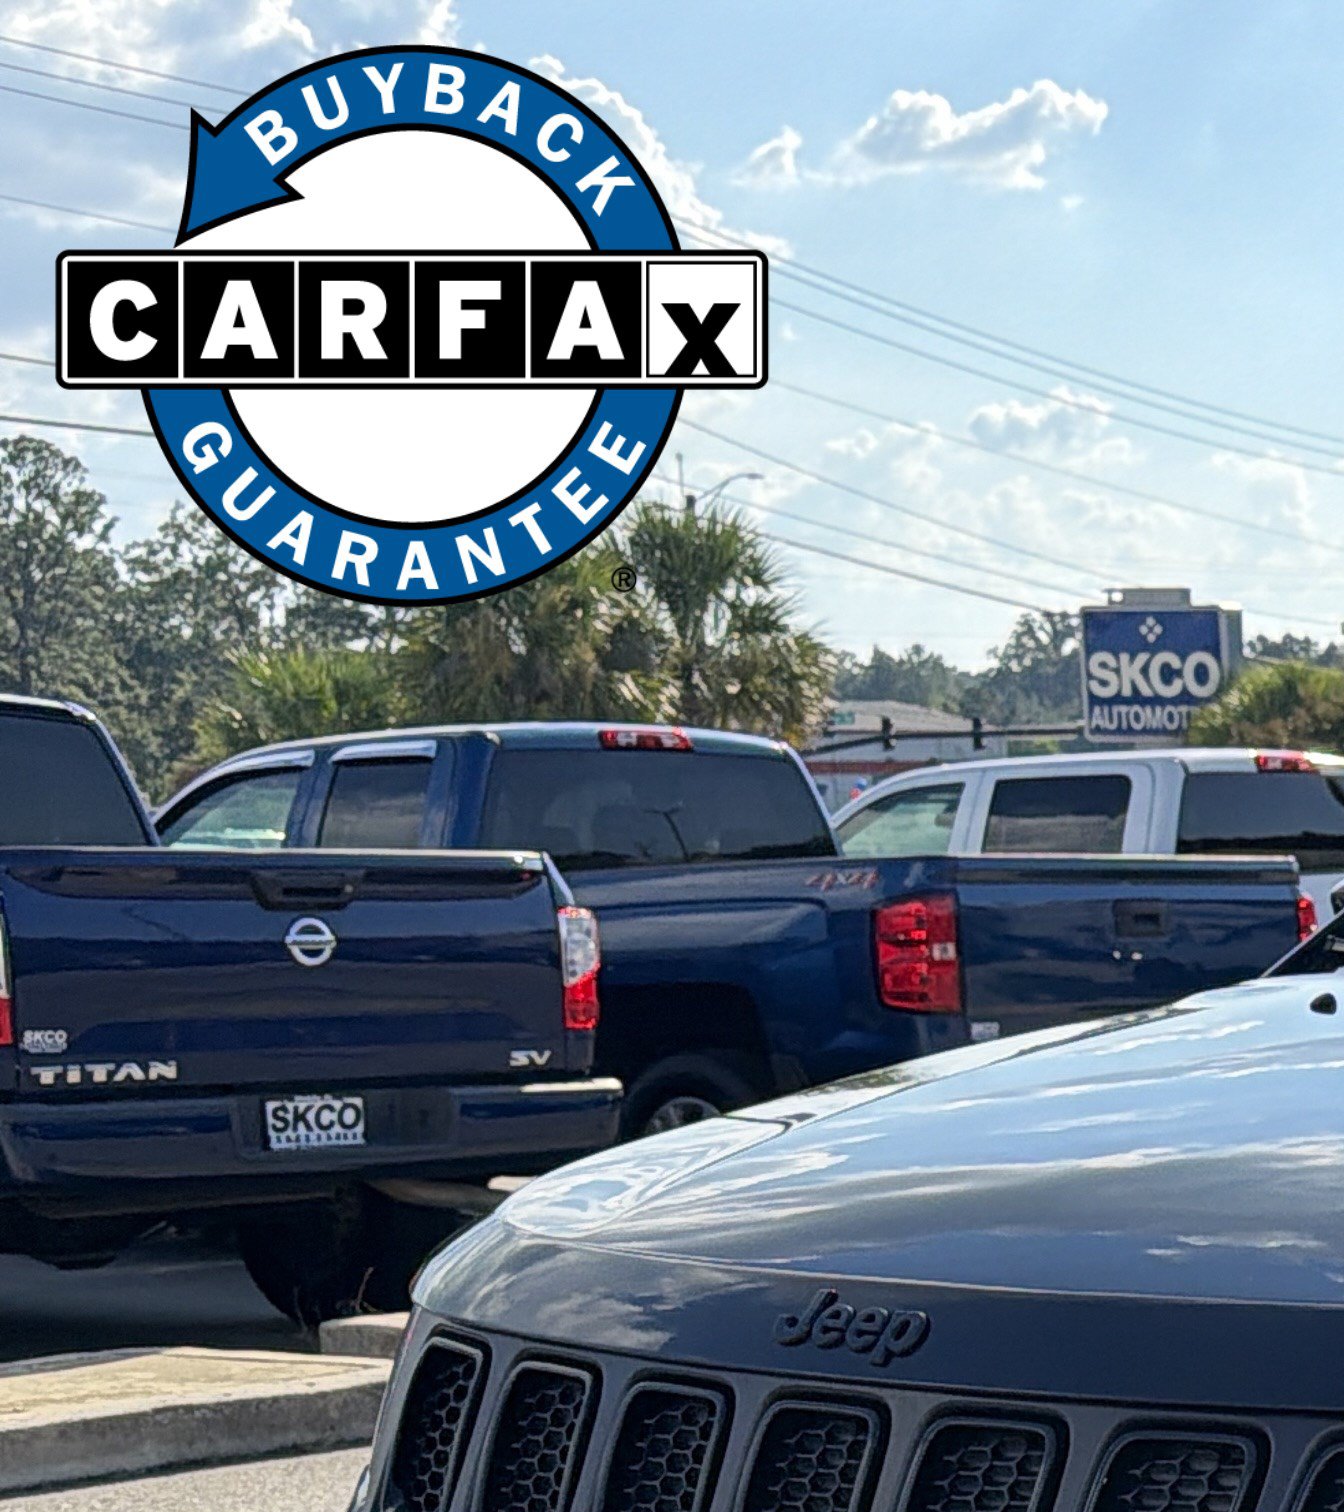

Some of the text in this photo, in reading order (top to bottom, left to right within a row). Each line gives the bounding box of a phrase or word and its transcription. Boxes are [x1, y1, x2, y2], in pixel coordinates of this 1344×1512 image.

[1088, 651, 1221, 698] SKCO
[1091, 704, 1200, 731] AUTOMOT
[23, 1029, 67, 1043] SKCO
[510, 1050, 551, 1066] SV
[30, 1060, 177, 1085] TITAN
[271, 1103, 361, 1132] SKCO
[774, 1289, 930, 1367] Jeep
